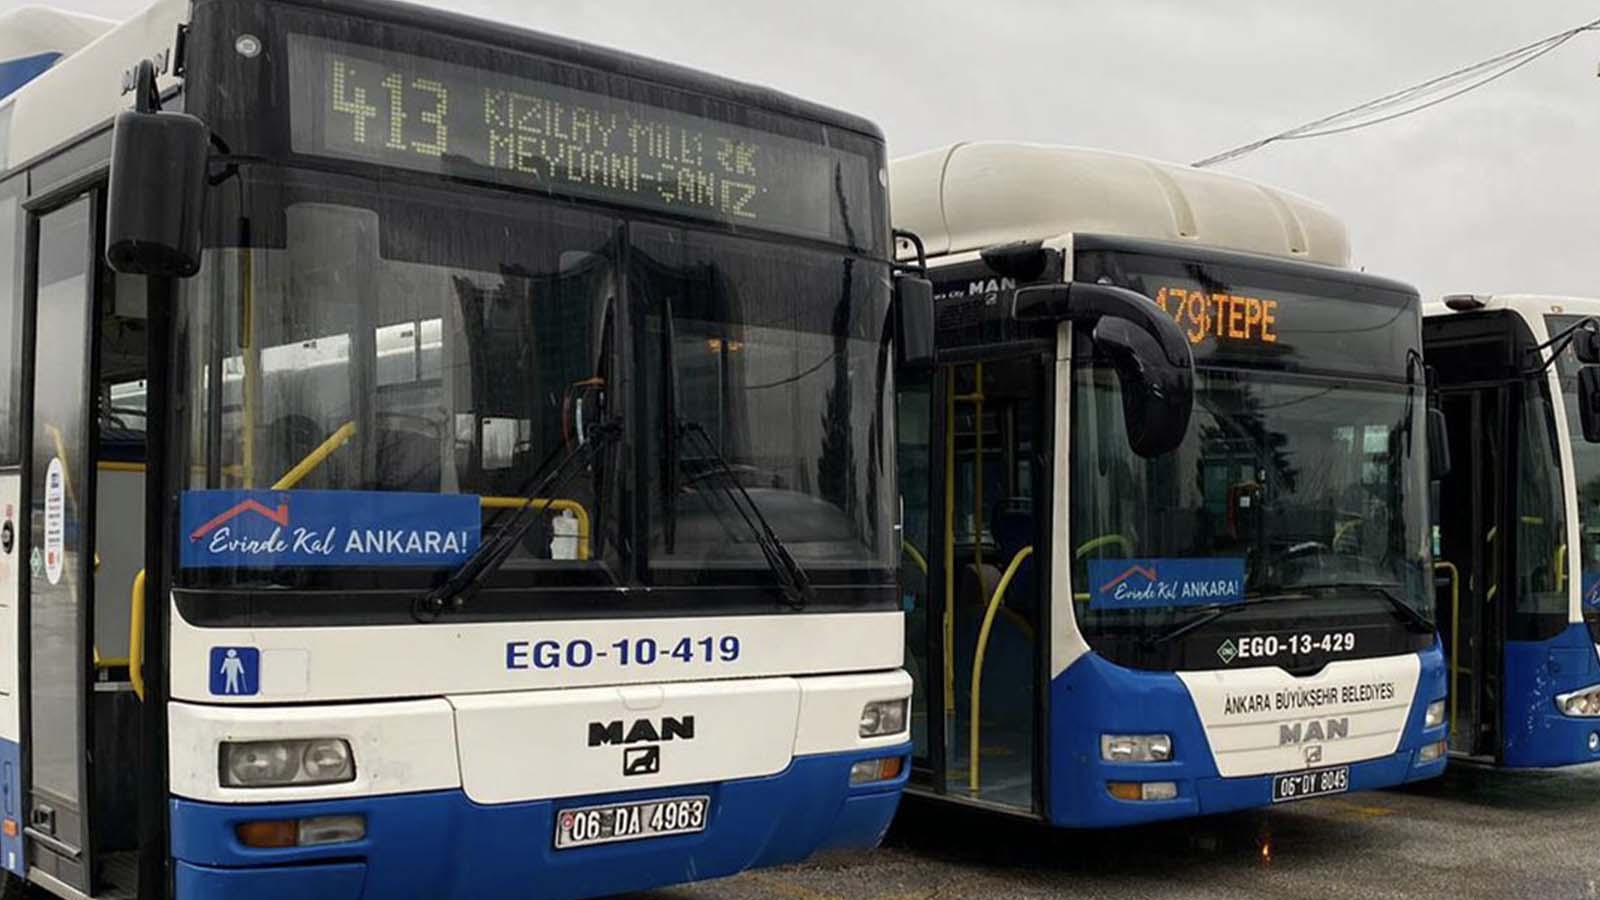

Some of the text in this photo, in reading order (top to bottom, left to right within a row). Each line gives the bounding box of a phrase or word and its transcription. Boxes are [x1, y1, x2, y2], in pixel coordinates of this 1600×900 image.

[333, 60, 447, 156] 413
[969, 277, 1016, 295] MAN
[208, 527, 468, 554] Evinde Kal ANKARA!
[1180, 579, 1239, 598] ANKARA!
[506, 635, 741, 670] EGO-10-419
[1238, 633, 1355, 658] EGO-13-429
[1224, 693, 1272, 715] ANKARA
[587, 715, 695, 748] MAN
[1279, 718, 1349, 744] MAN
[1280, 777, 1296, 797] 06
[572, 800, 705, 841] 06 DA 4963
